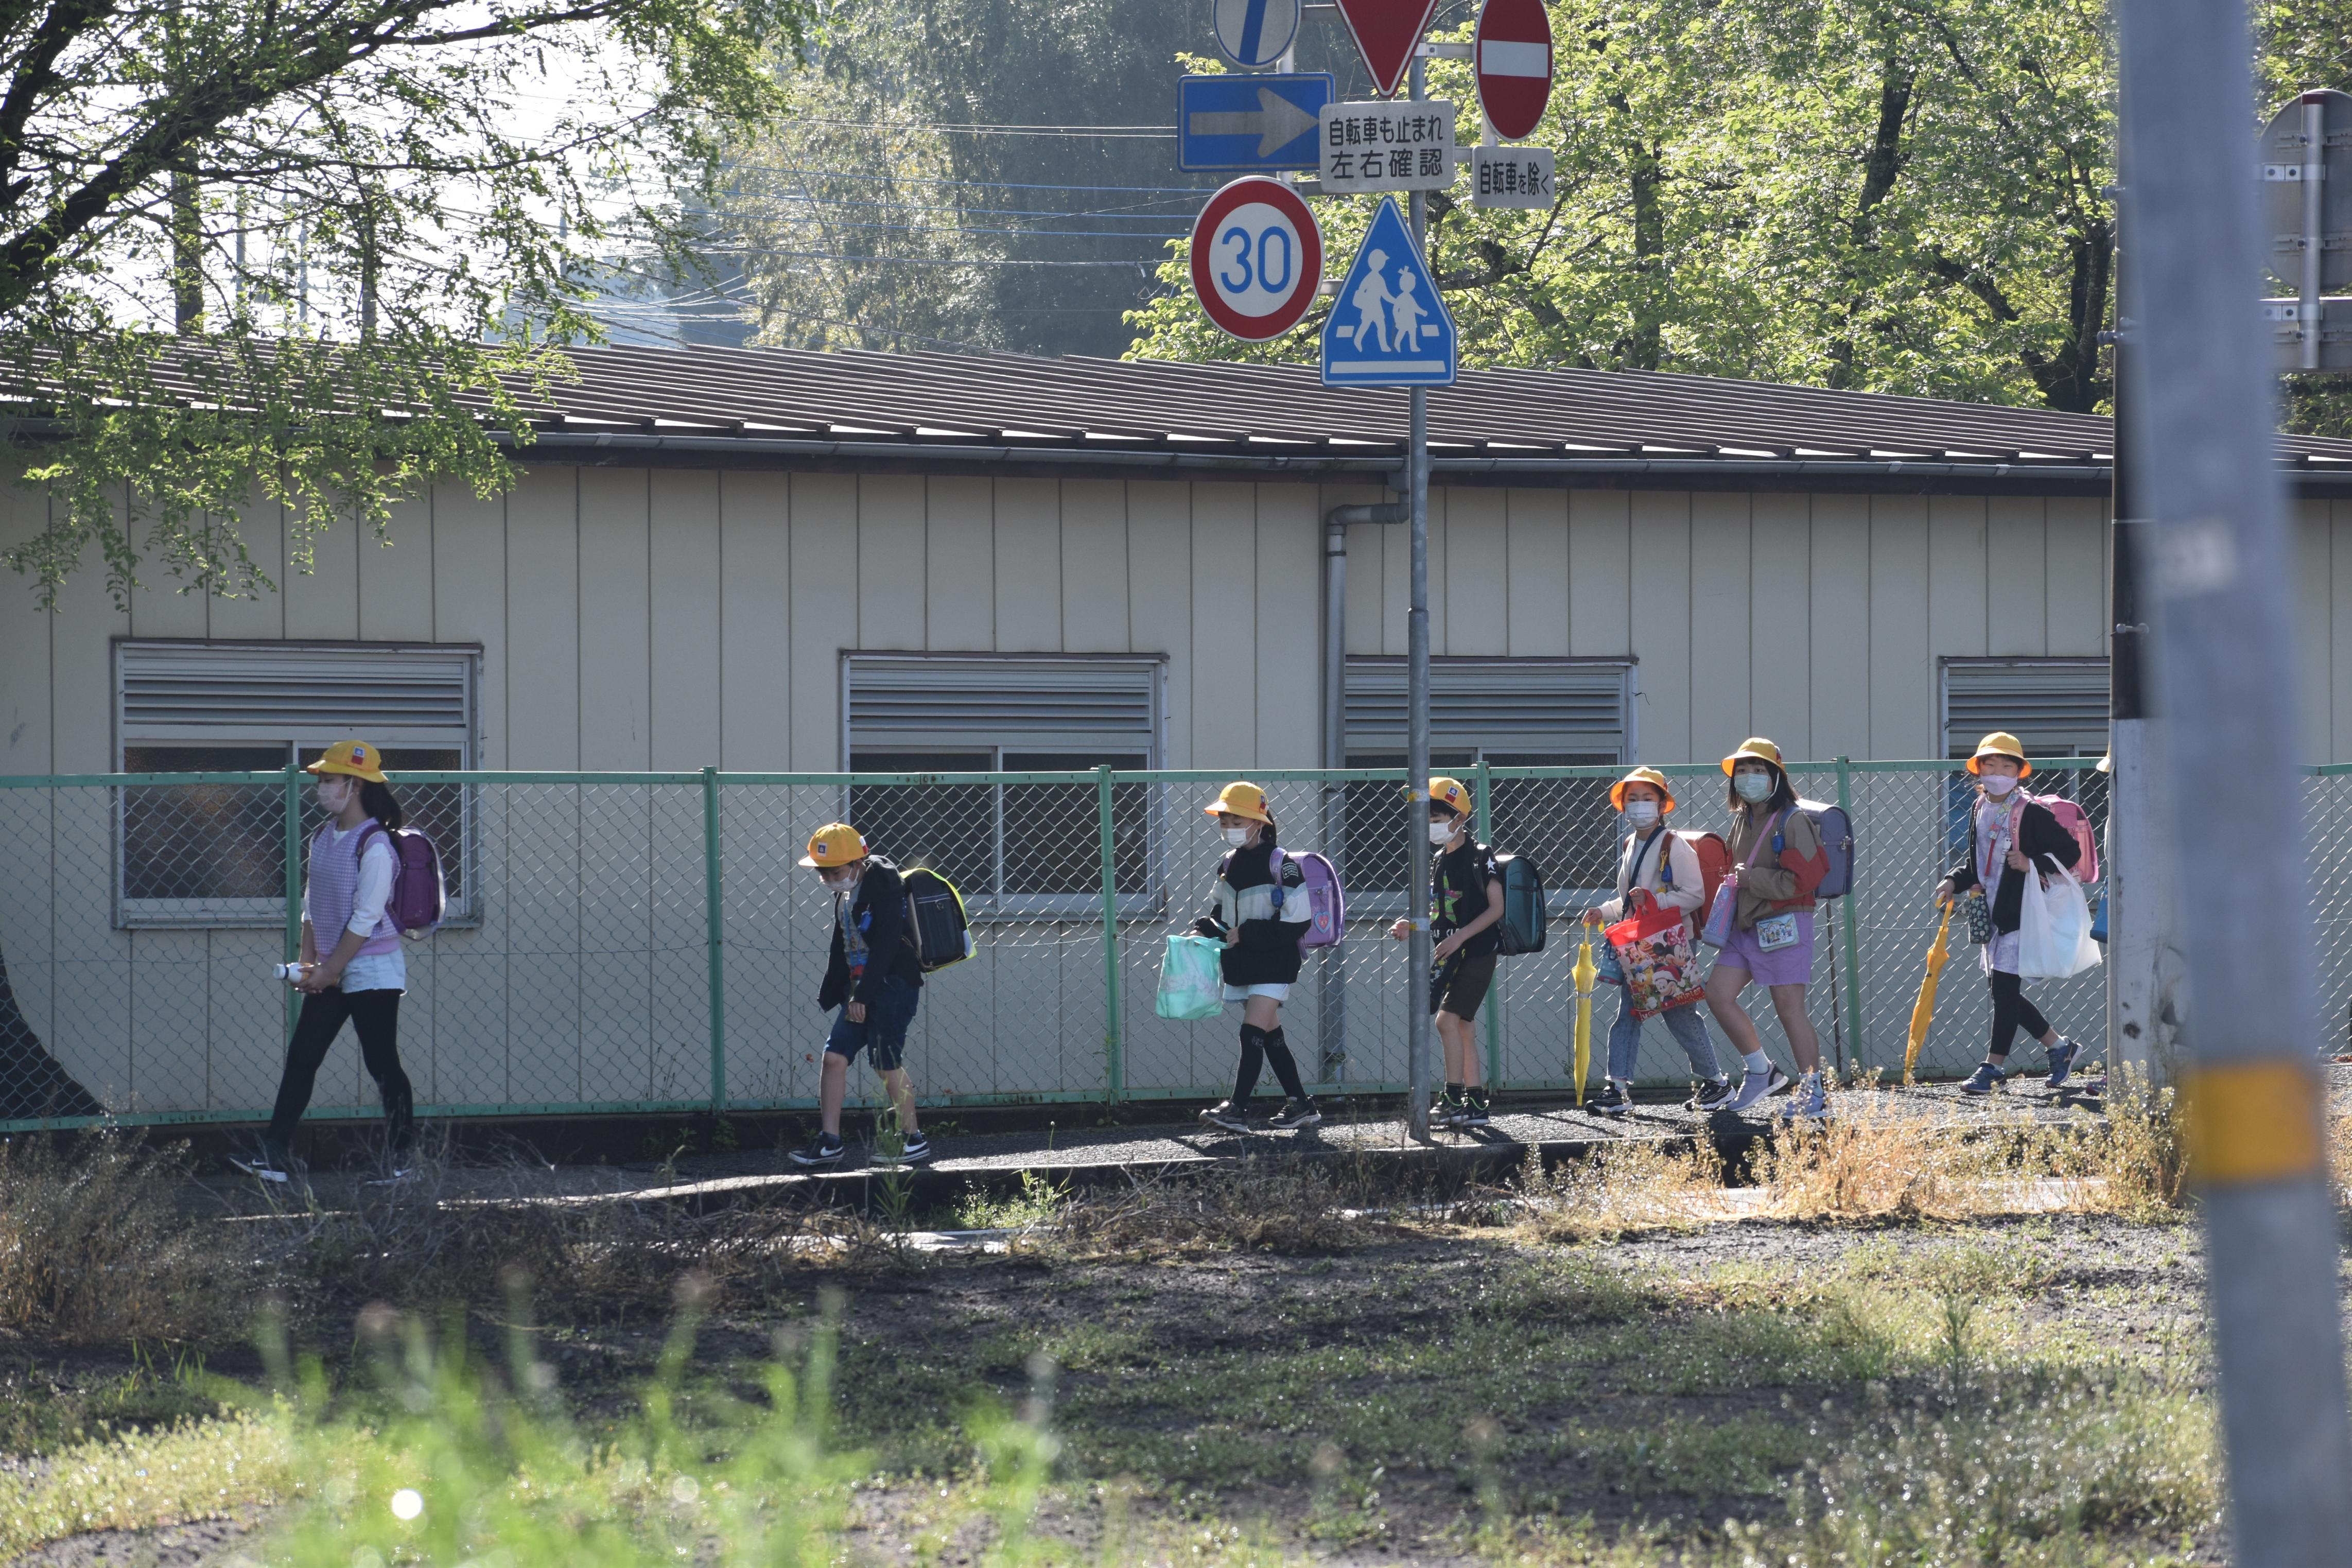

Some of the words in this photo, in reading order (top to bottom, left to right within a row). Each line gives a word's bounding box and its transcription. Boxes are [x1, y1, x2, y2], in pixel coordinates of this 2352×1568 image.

[1329, 115, 1443, 146] 自転車も止まれ
[1330, 149, 1443, 180] 左右確認
[1479, 161, 1549, 196] 自転車を除く
[1221, 226, 1291, 294] 30
